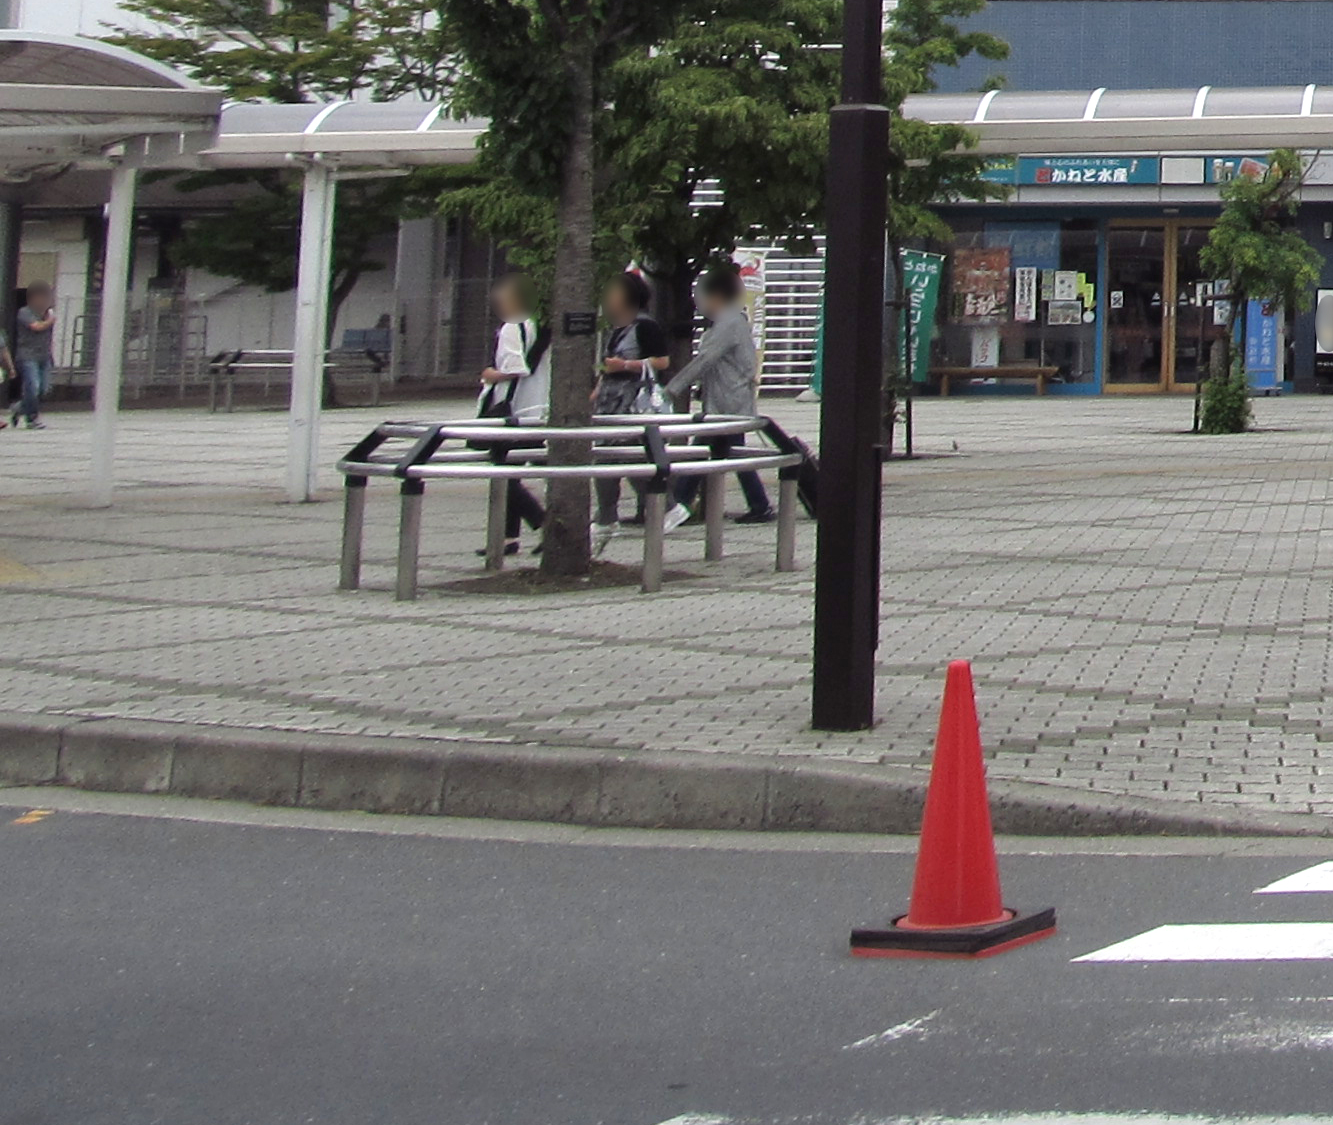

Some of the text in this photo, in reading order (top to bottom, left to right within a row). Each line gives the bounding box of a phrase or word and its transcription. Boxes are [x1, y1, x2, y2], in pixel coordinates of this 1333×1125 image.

[1051, 168, 1128, 183] かねと水産
